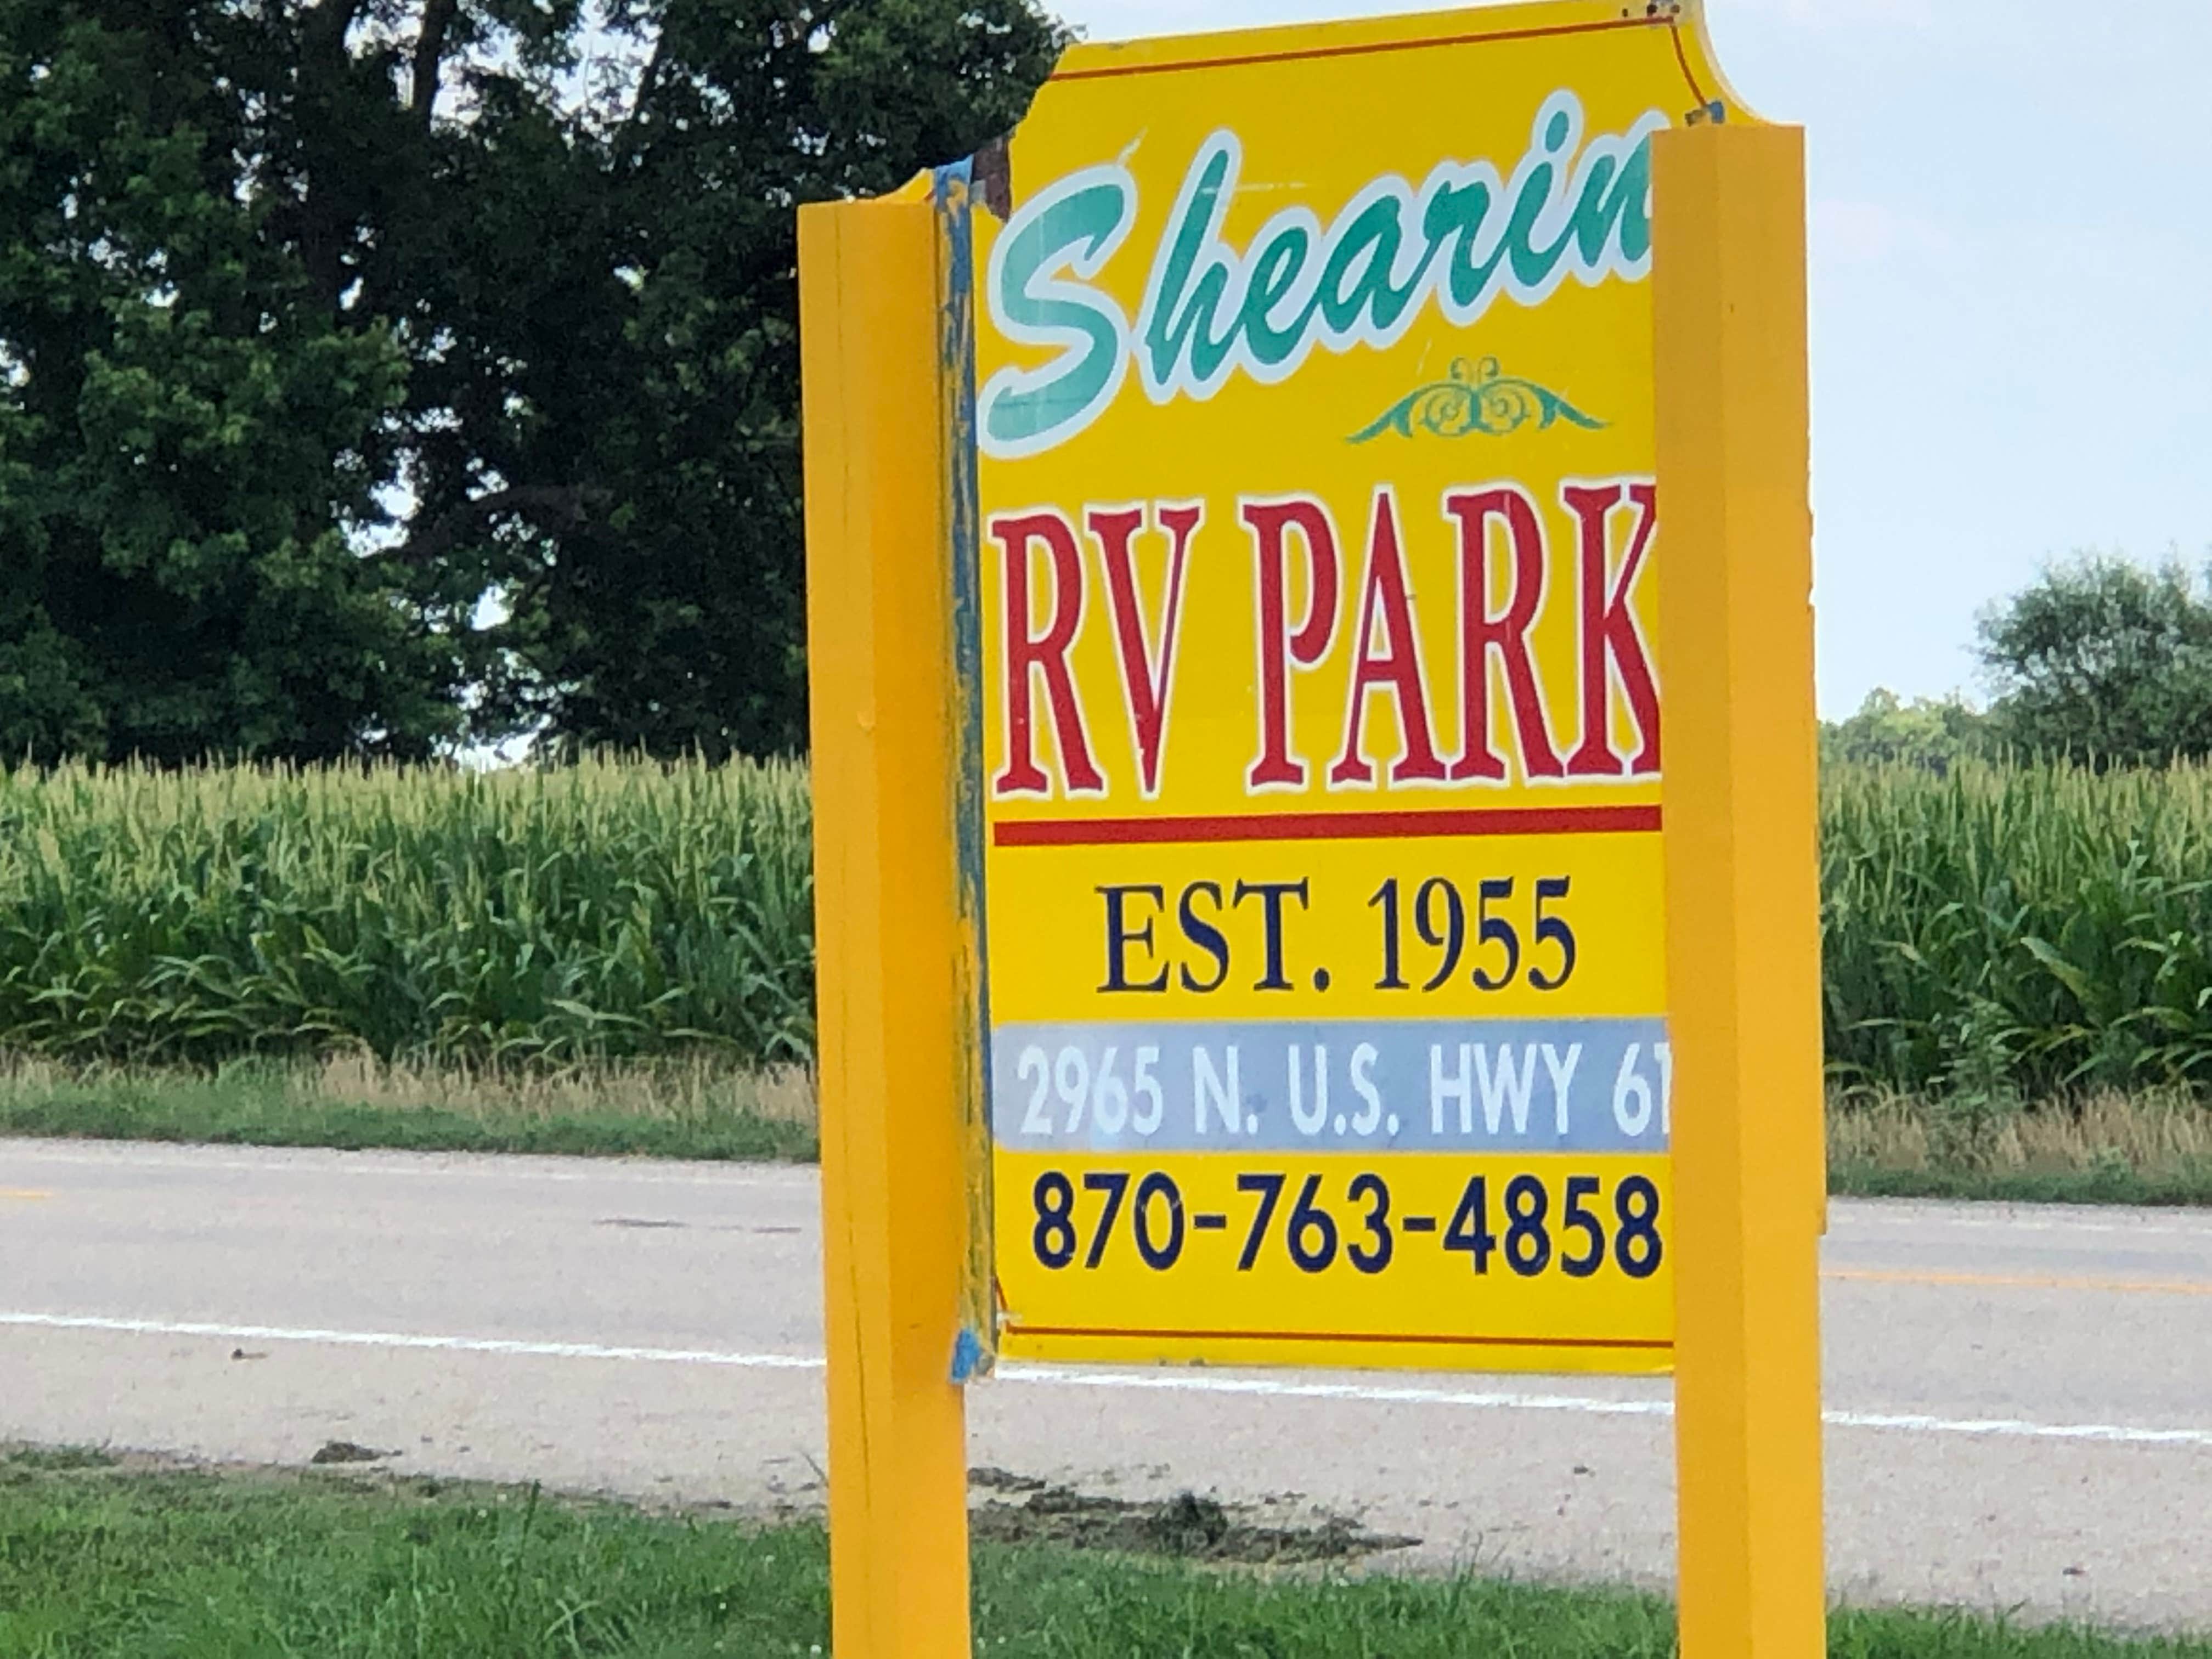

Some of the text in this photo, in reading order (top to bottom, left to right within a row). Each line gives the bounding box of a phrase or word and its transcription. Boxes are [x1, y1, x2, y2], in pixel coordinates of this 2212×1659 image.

[977, 89, 1669, 459] Shearin
[988, 475, 1662, 801] RV PARK
[1094, 874, 1576, 993] EST. 1955
[1017, 1044, 1162, 1135] 2965
[1194, 1044, 1259, 1135] N.
[1288, 1041, 1400, 1135] U.S.
[1431, 1041, 1583, 1134] HWY
[1032, 1171, 1663, 1278] 870-763-4858
